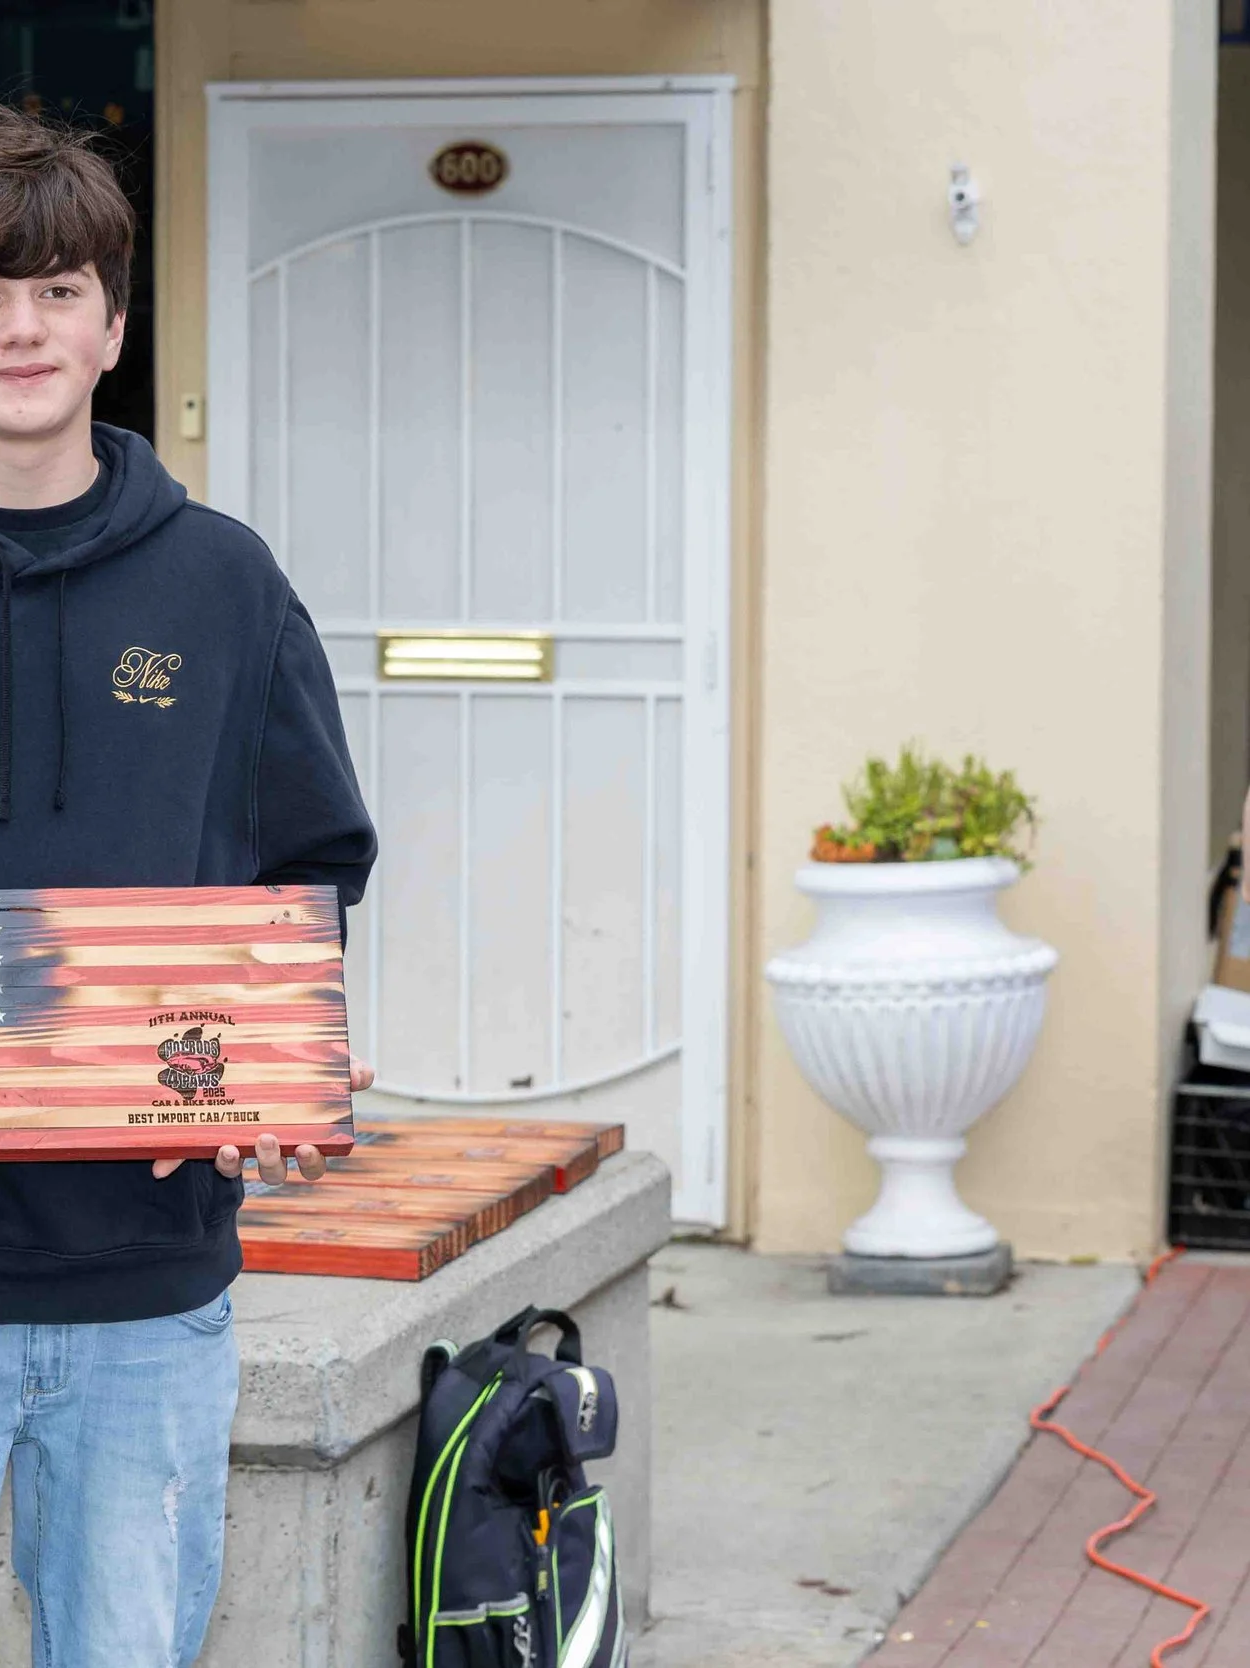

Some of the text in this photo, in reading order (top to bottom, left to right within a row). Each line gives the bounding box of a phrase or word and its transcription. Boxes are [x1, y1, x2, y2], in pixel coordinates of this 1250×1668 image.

[442, 150, 499, 184] 600
[112, 646, 182, 690] Nike
[149, 1011, 236, 1028] 11TH ANNUAL
[187, 1040, 219, 1057] RODS
[167, 1069, 220, 1088] 4 PAWS
[203, 1087, 226, 1098] 2025
[207, 1099, 235, 1107] SHOW
[128, 1111, 261, 1124] BEST IMPORT CAR/TRUCK
